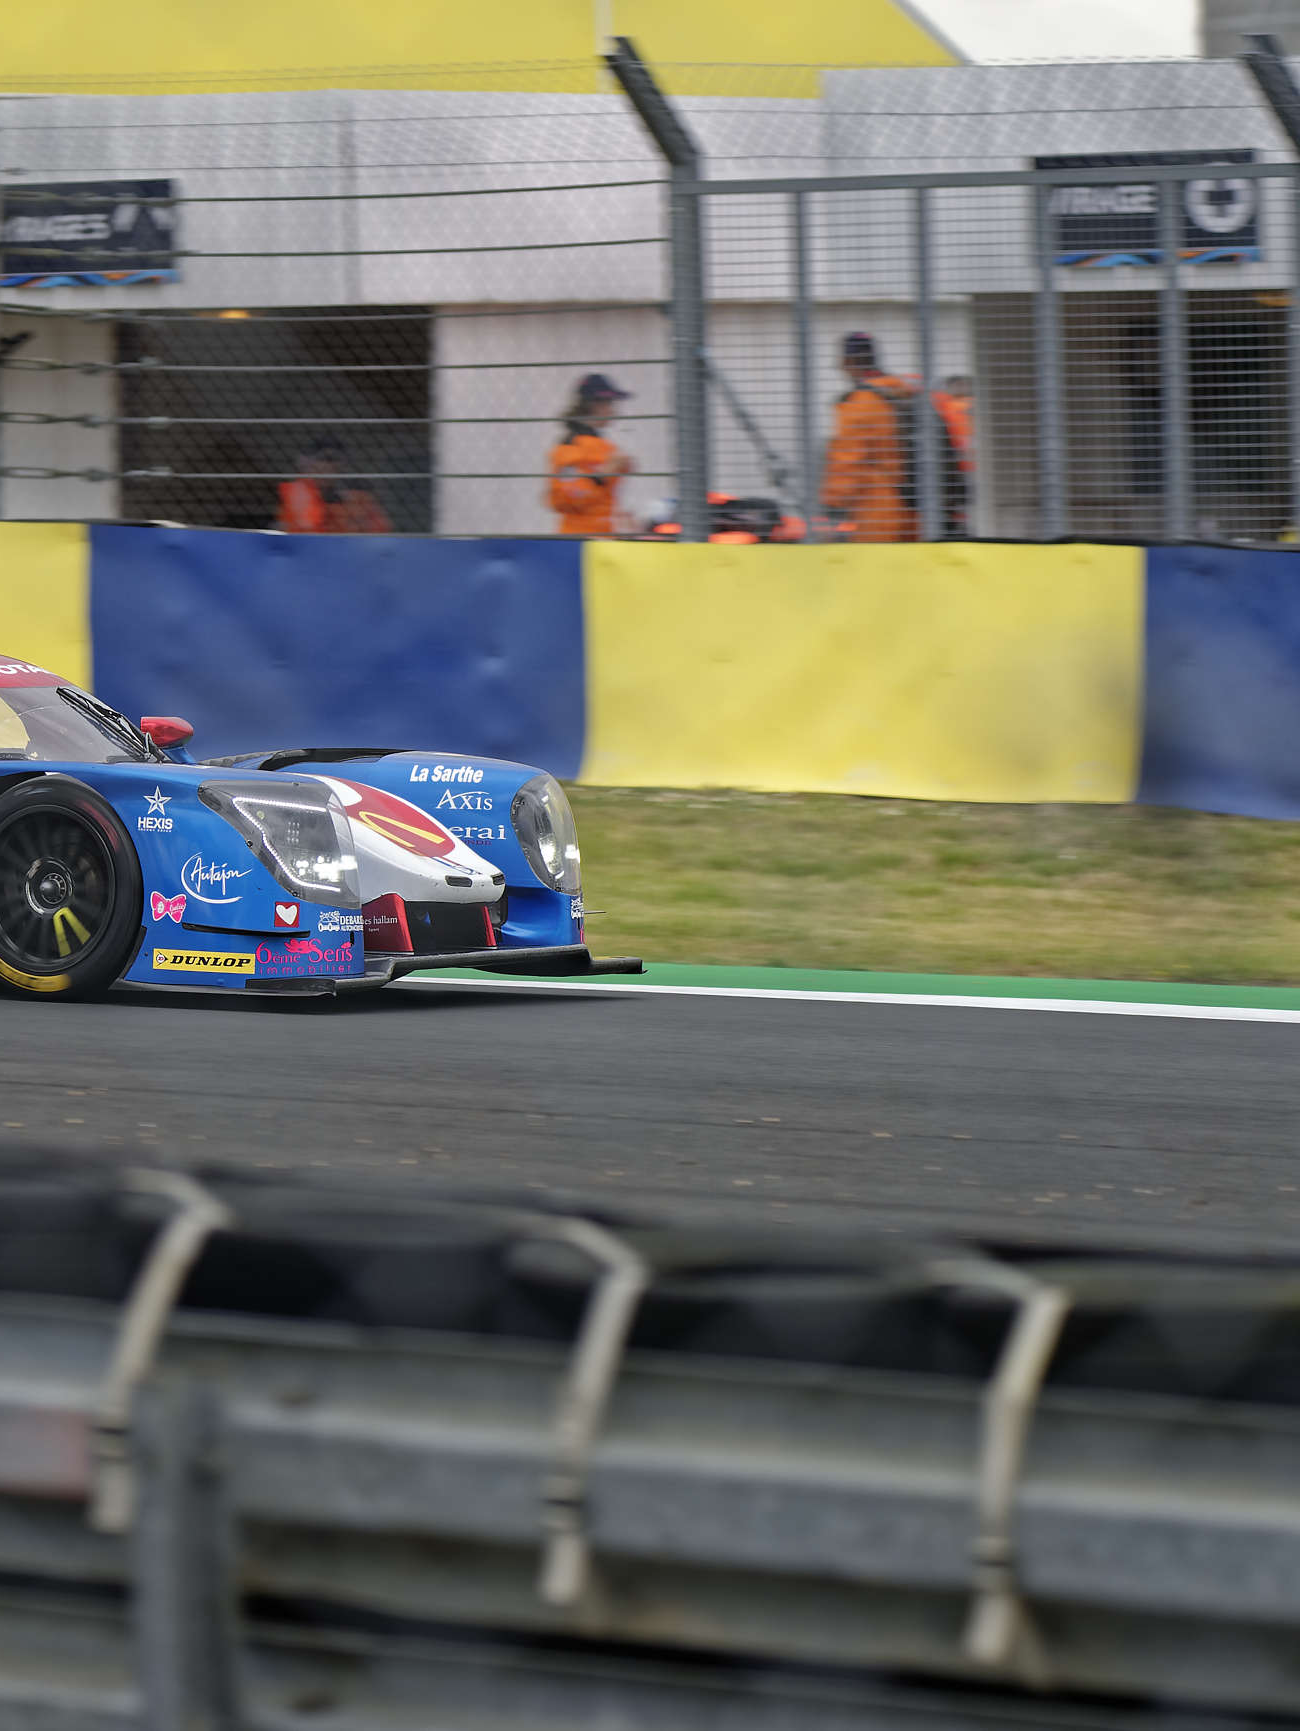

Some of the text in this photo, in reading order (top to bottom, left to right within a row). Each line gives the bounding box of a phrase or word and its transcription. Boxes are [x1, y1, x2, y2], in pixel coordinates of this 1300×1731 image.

[409, 764, 484, 783] La Sarthe
[137, 816, 173, 829] HEXIS
[448, 824, 507, 840] erai
[373, 916, 398, 925] hallam
[170, 954, 251, 968] DUNLOP
[259, 964, 351, 976] immobilier
